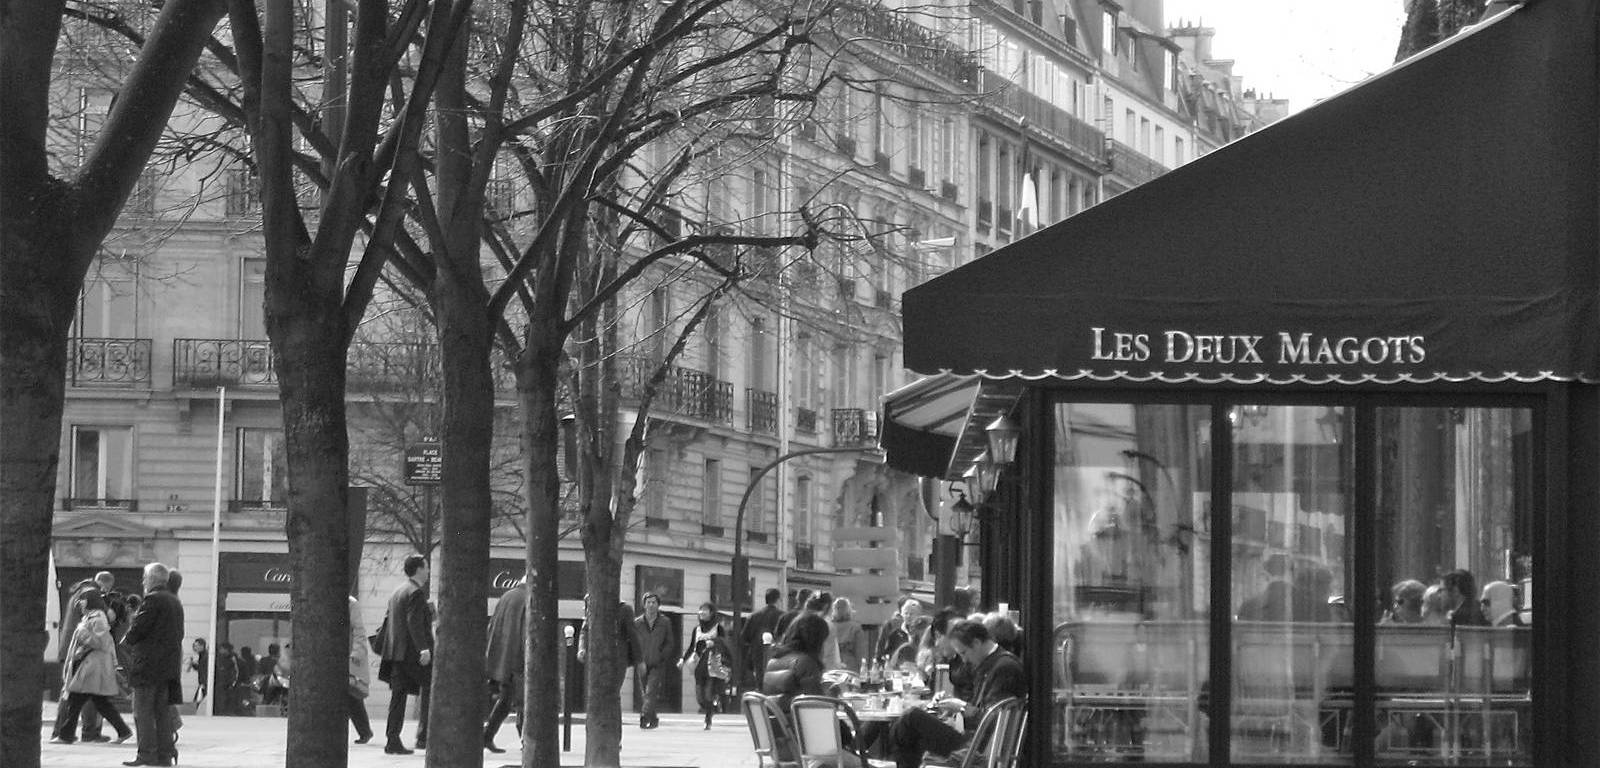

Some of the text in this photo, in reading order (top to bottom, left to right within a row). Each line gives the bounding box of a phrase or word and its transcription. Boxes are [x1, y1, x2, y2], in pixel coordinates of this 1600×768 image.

[1091, 327, 1426, 364] LES DEUX MAGOTS
